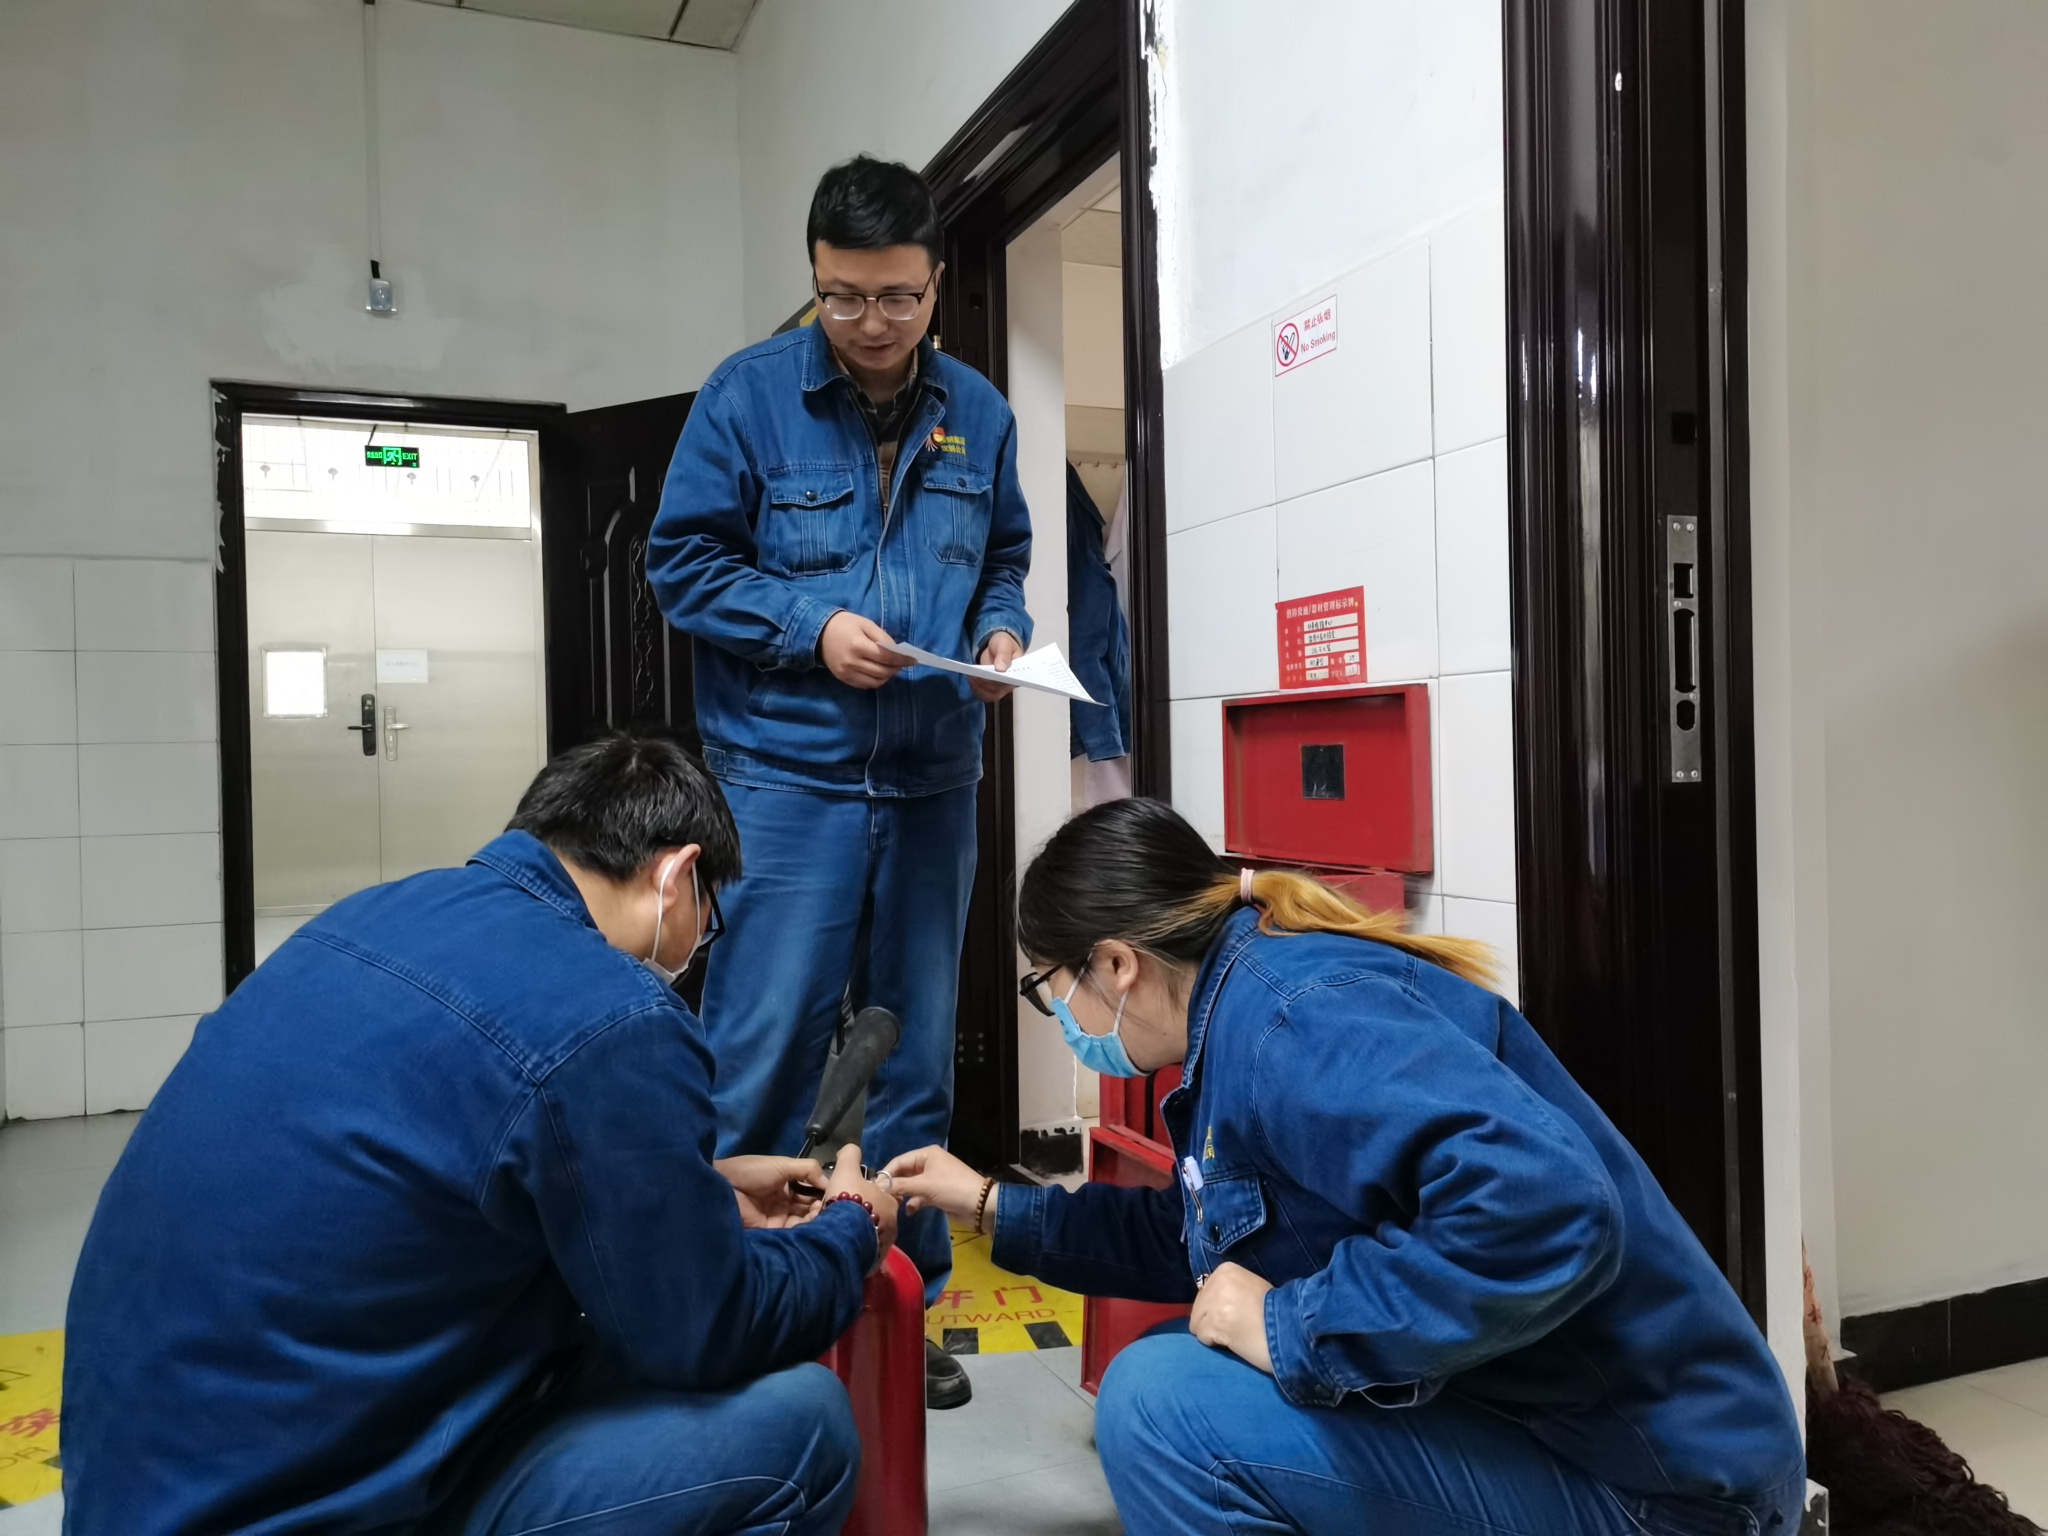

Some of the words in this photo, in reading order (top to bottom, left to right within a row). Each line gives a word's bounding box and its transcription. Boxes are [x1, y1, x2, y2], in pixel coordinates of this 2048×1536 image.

[1303, 308, 1331, 331] 禁止吸烟
[1301, 343, 1310, 354] No
[1310, 331, 1336, 349] Smoking
[402, 452, 418, 460] EXIT
[926, 1308, 1056, 1325] UTWARD
